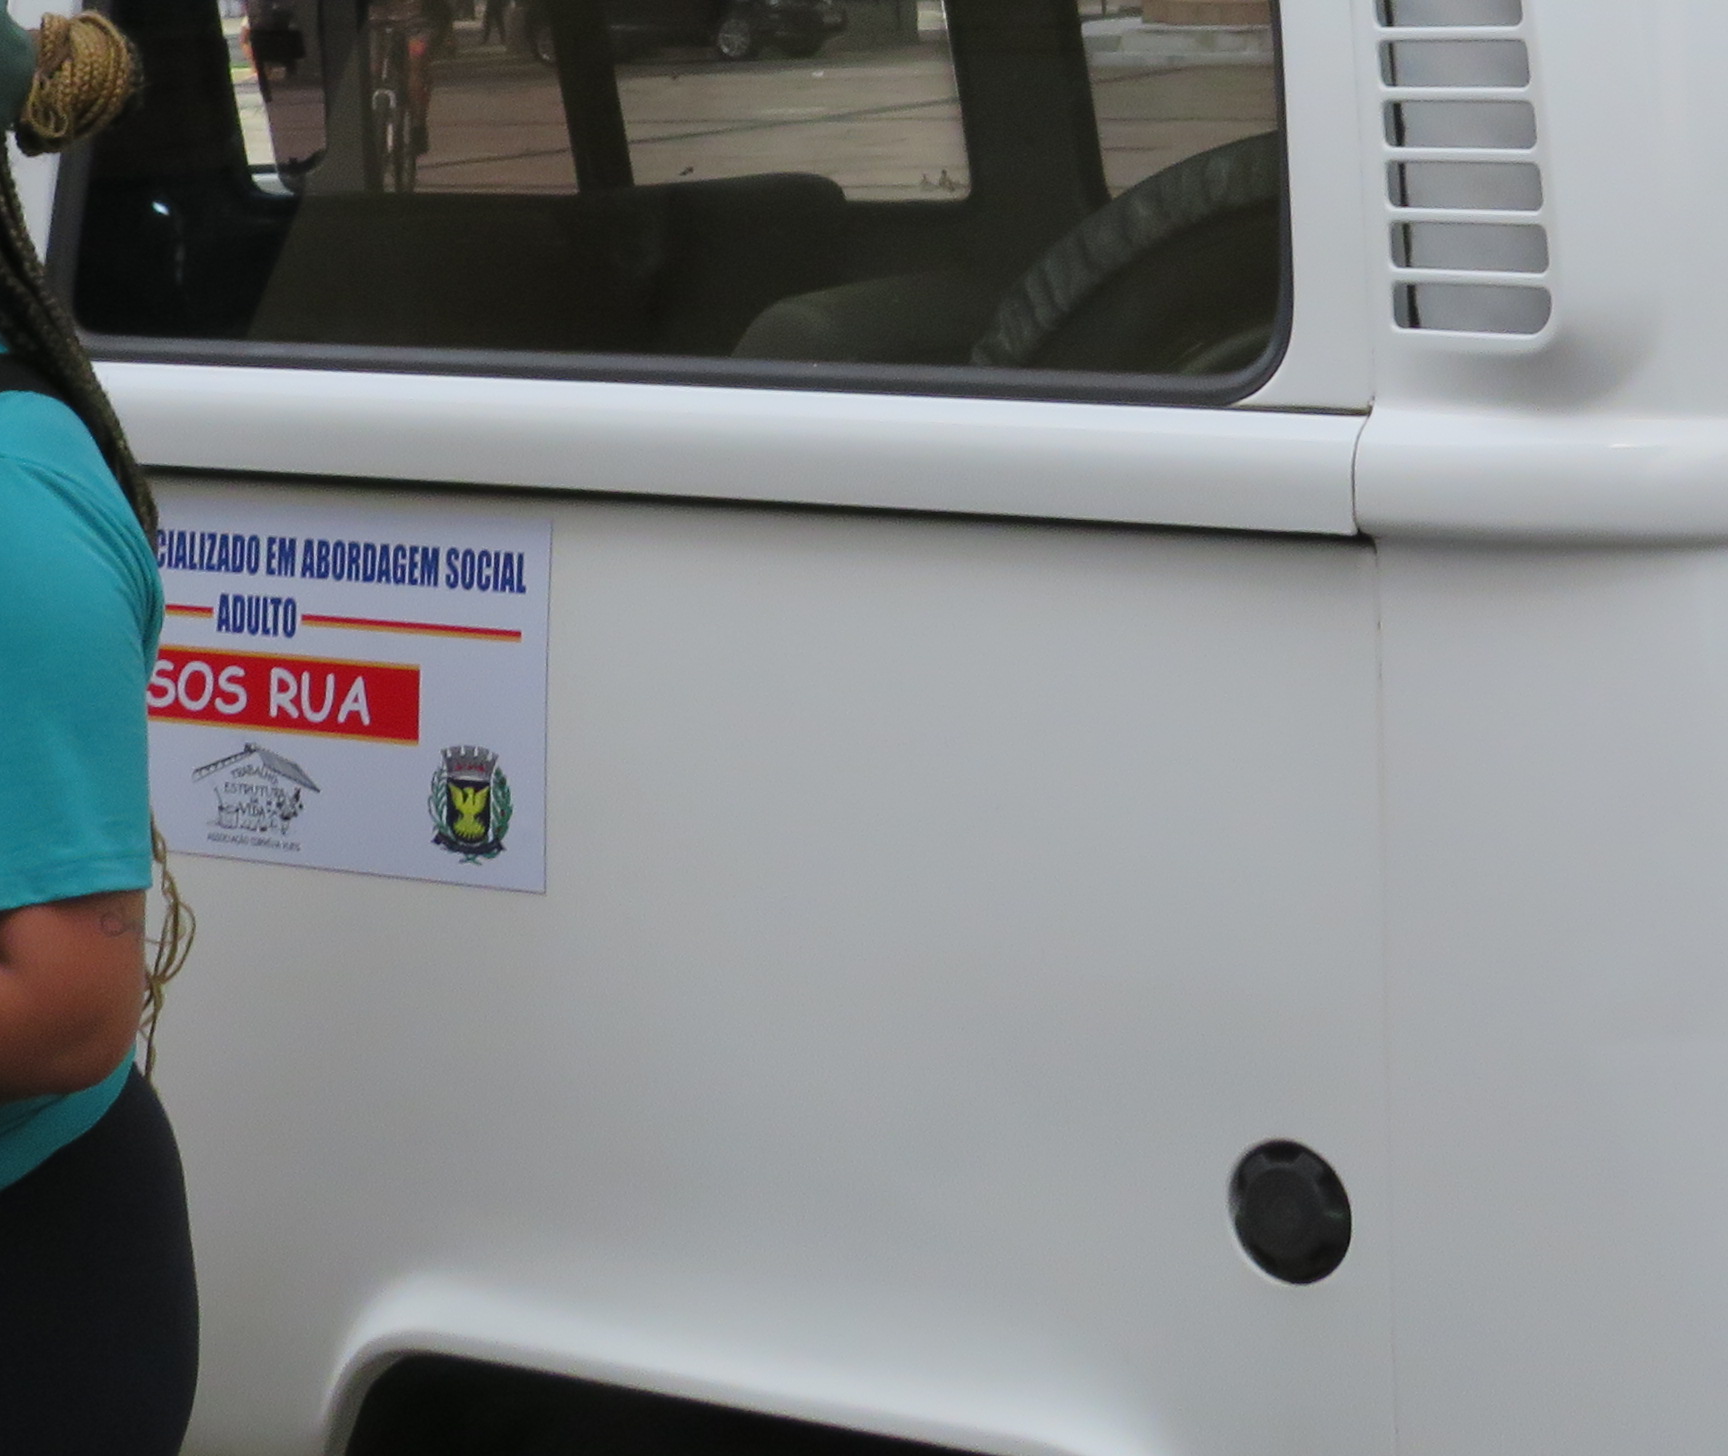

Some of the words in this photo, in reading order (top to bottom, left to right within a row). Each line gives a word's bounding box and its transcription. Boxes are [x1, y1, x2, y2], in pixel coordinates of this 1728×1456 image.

[266, 536, 297, 577] EM
[301, 538, 440, 588] ABORDAGEM
[445, 547, 527, 594] SOCIAL
[216, 592, 297, 638] ADULTO
[147, 659, 248, 715] SOS
[269, 666, 371, 726] RUA
